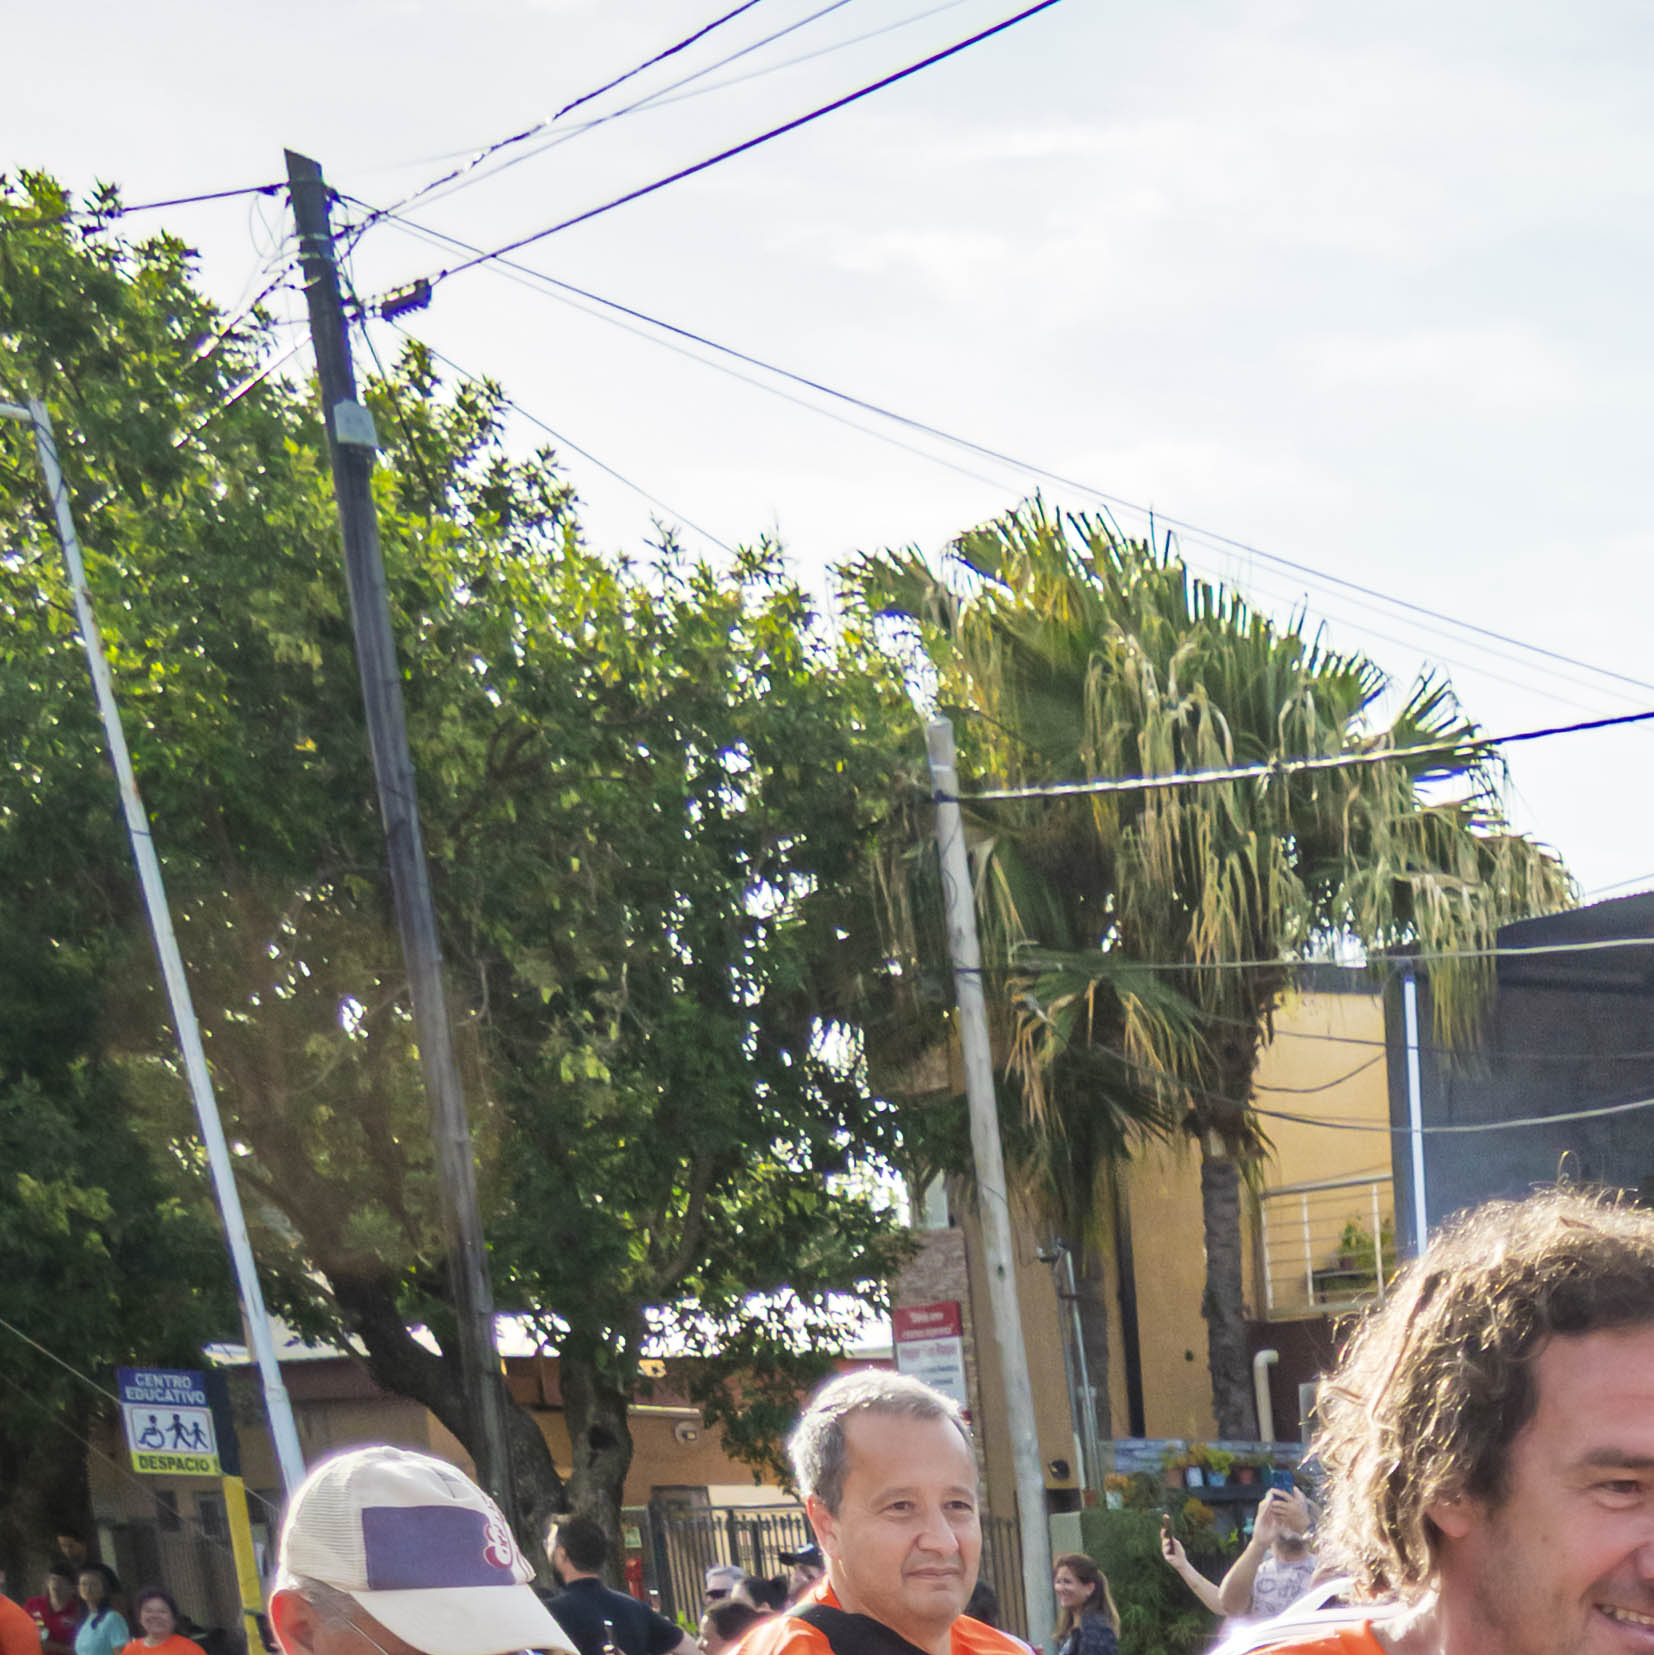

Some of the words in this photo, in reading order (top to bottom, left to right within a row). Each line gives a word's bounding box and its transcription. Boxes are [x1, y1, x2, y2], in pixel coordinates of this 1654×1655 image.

[135, 1373, 192, 1390] CENTRO
[125, 1386, 207, 1405] EDUCATIVO
[138, 1455, 210, 1472] DESPACIO
